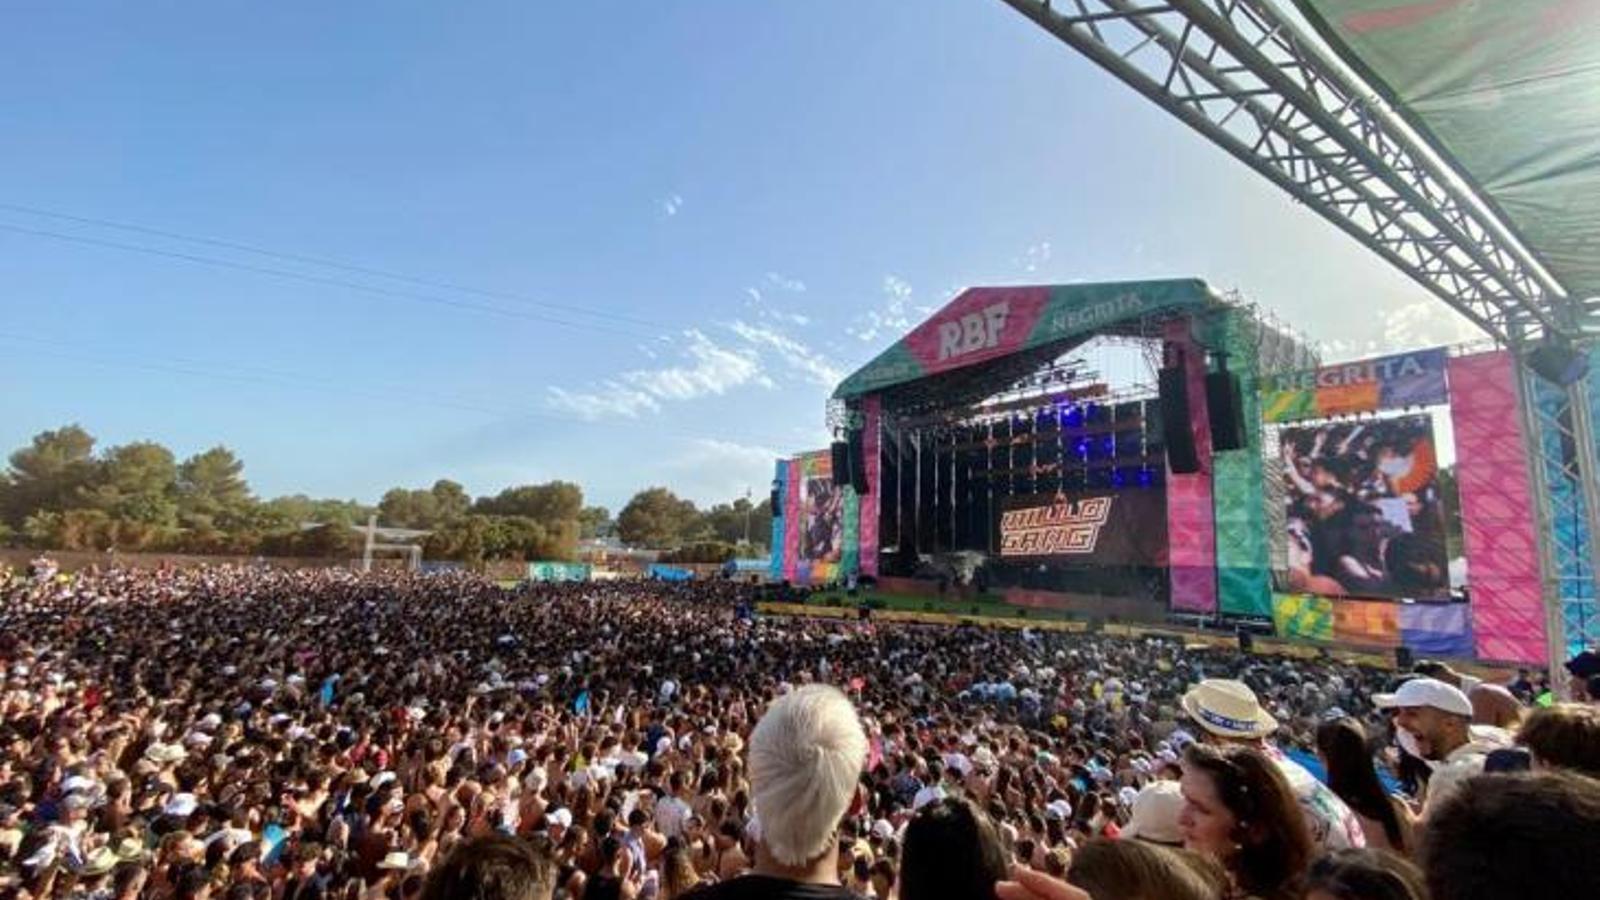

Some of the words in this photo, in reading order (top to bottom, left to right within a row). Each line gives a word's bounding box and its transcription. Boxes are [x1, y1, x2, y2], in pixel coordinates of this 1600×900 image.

[1050, 291, 1143, 332] NEGRITA
[938, 302, 1010, 362] RBF
[1275, 356, 1424, 391] NEGRITA
[1000, 523, 1099, 555] GANG
